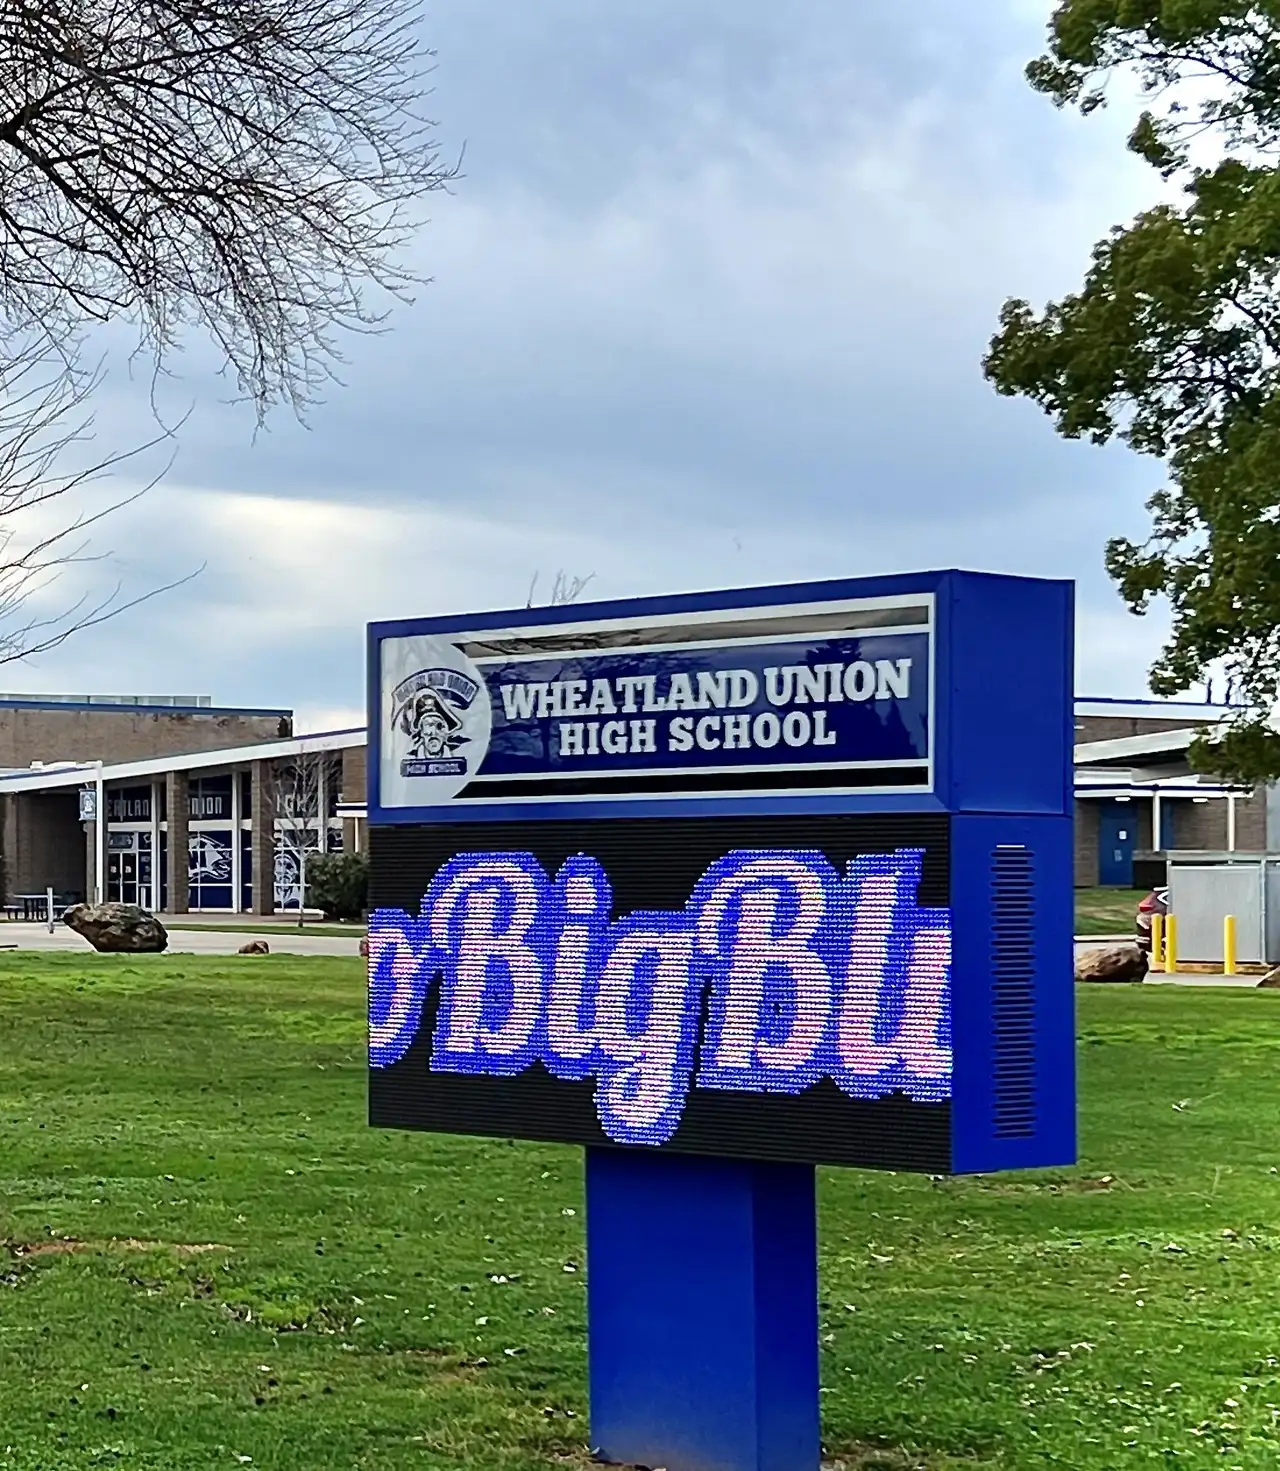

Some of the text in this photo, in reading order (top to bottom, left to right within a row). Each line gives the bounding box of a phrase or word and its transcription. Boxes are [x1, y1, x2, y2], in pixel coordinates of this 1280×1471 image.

[500, 668, 759, 719] WHEATLAND
[763, 658, 912, 706] UNION
[559, 710, 837, 756] HIGH SCHOOL
[187, 797, 222, 815] NION
